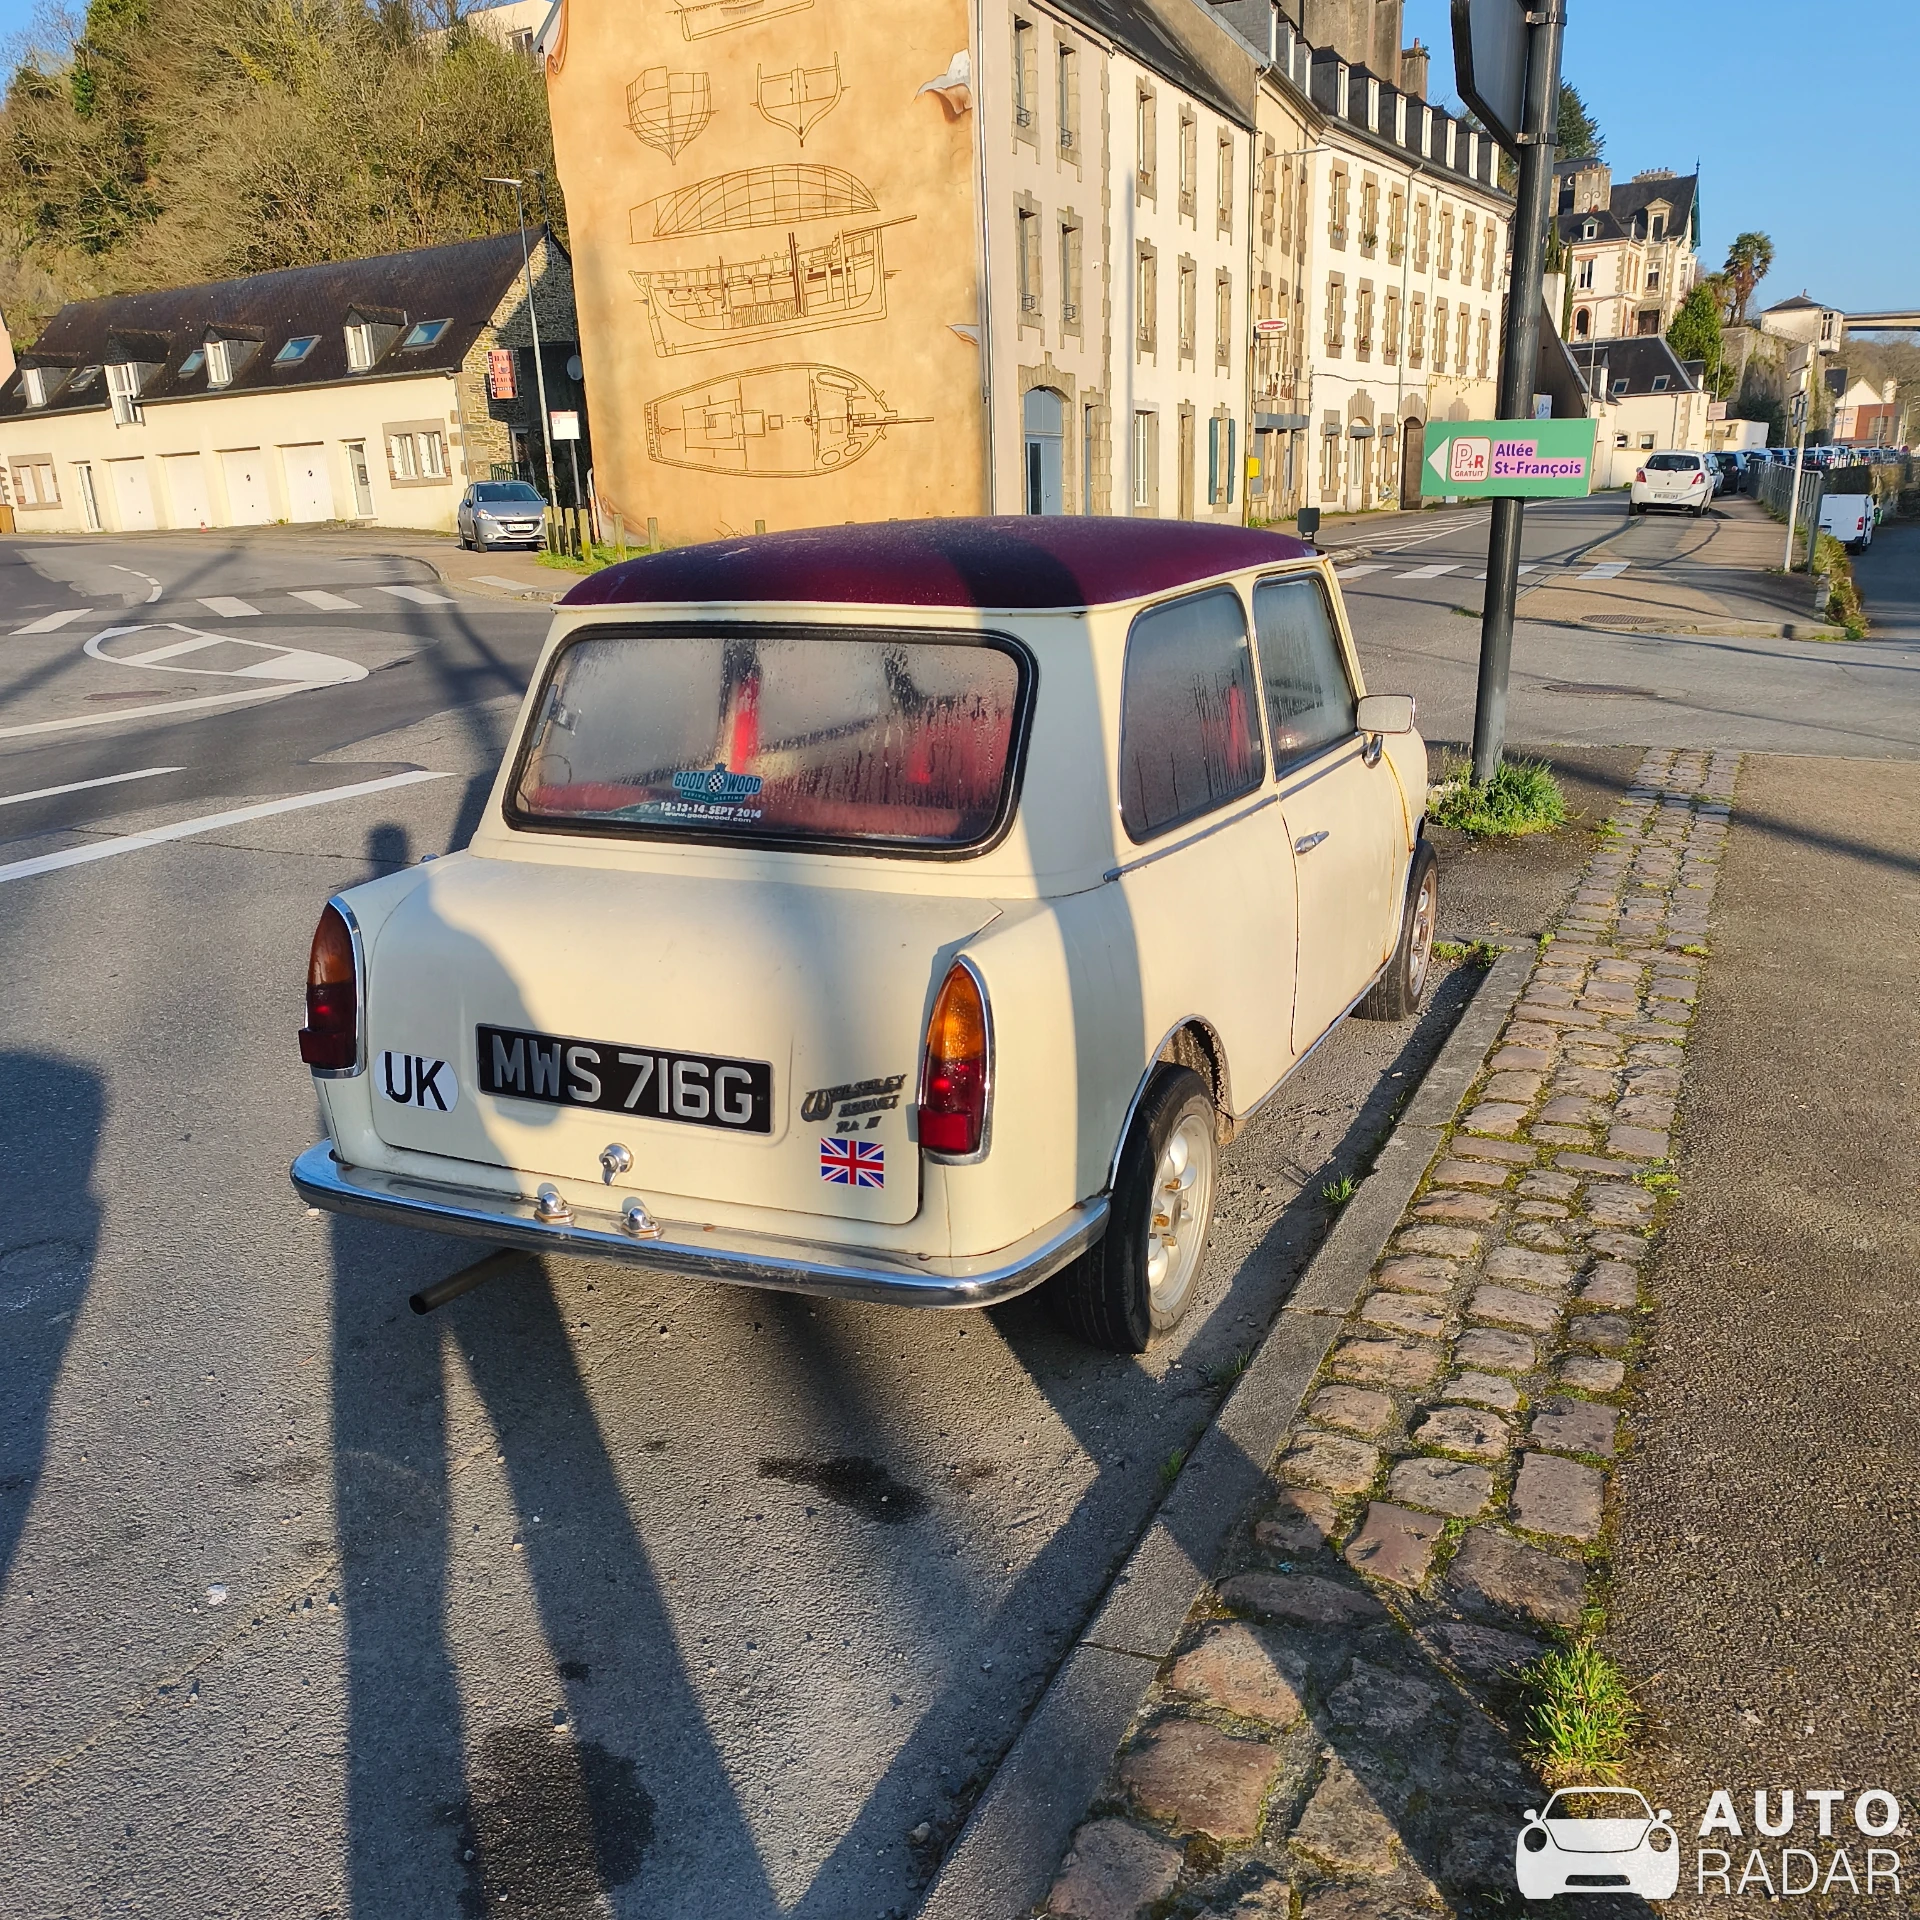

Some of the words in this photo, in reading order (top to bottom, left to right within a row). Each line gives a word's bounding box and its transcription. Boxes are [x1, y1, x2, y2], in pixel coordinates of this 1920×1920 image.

[1496, 443, 1533, 457] Allée
[1494, 461, 1581, 477] St-François
[674, 772, 705, 790] GOOD
[727, 774, 761, 793] WOOD
[665, 811, 752, 823] www.goodwood.com
[708, 805, 734, 816] SEPT
[736, 808, 762, 818] 2014
[384, 1051, 448, 1111] UK
[492, 1035, 602, 1102] MWS
[618, 1053, 753, 1124] 716G
